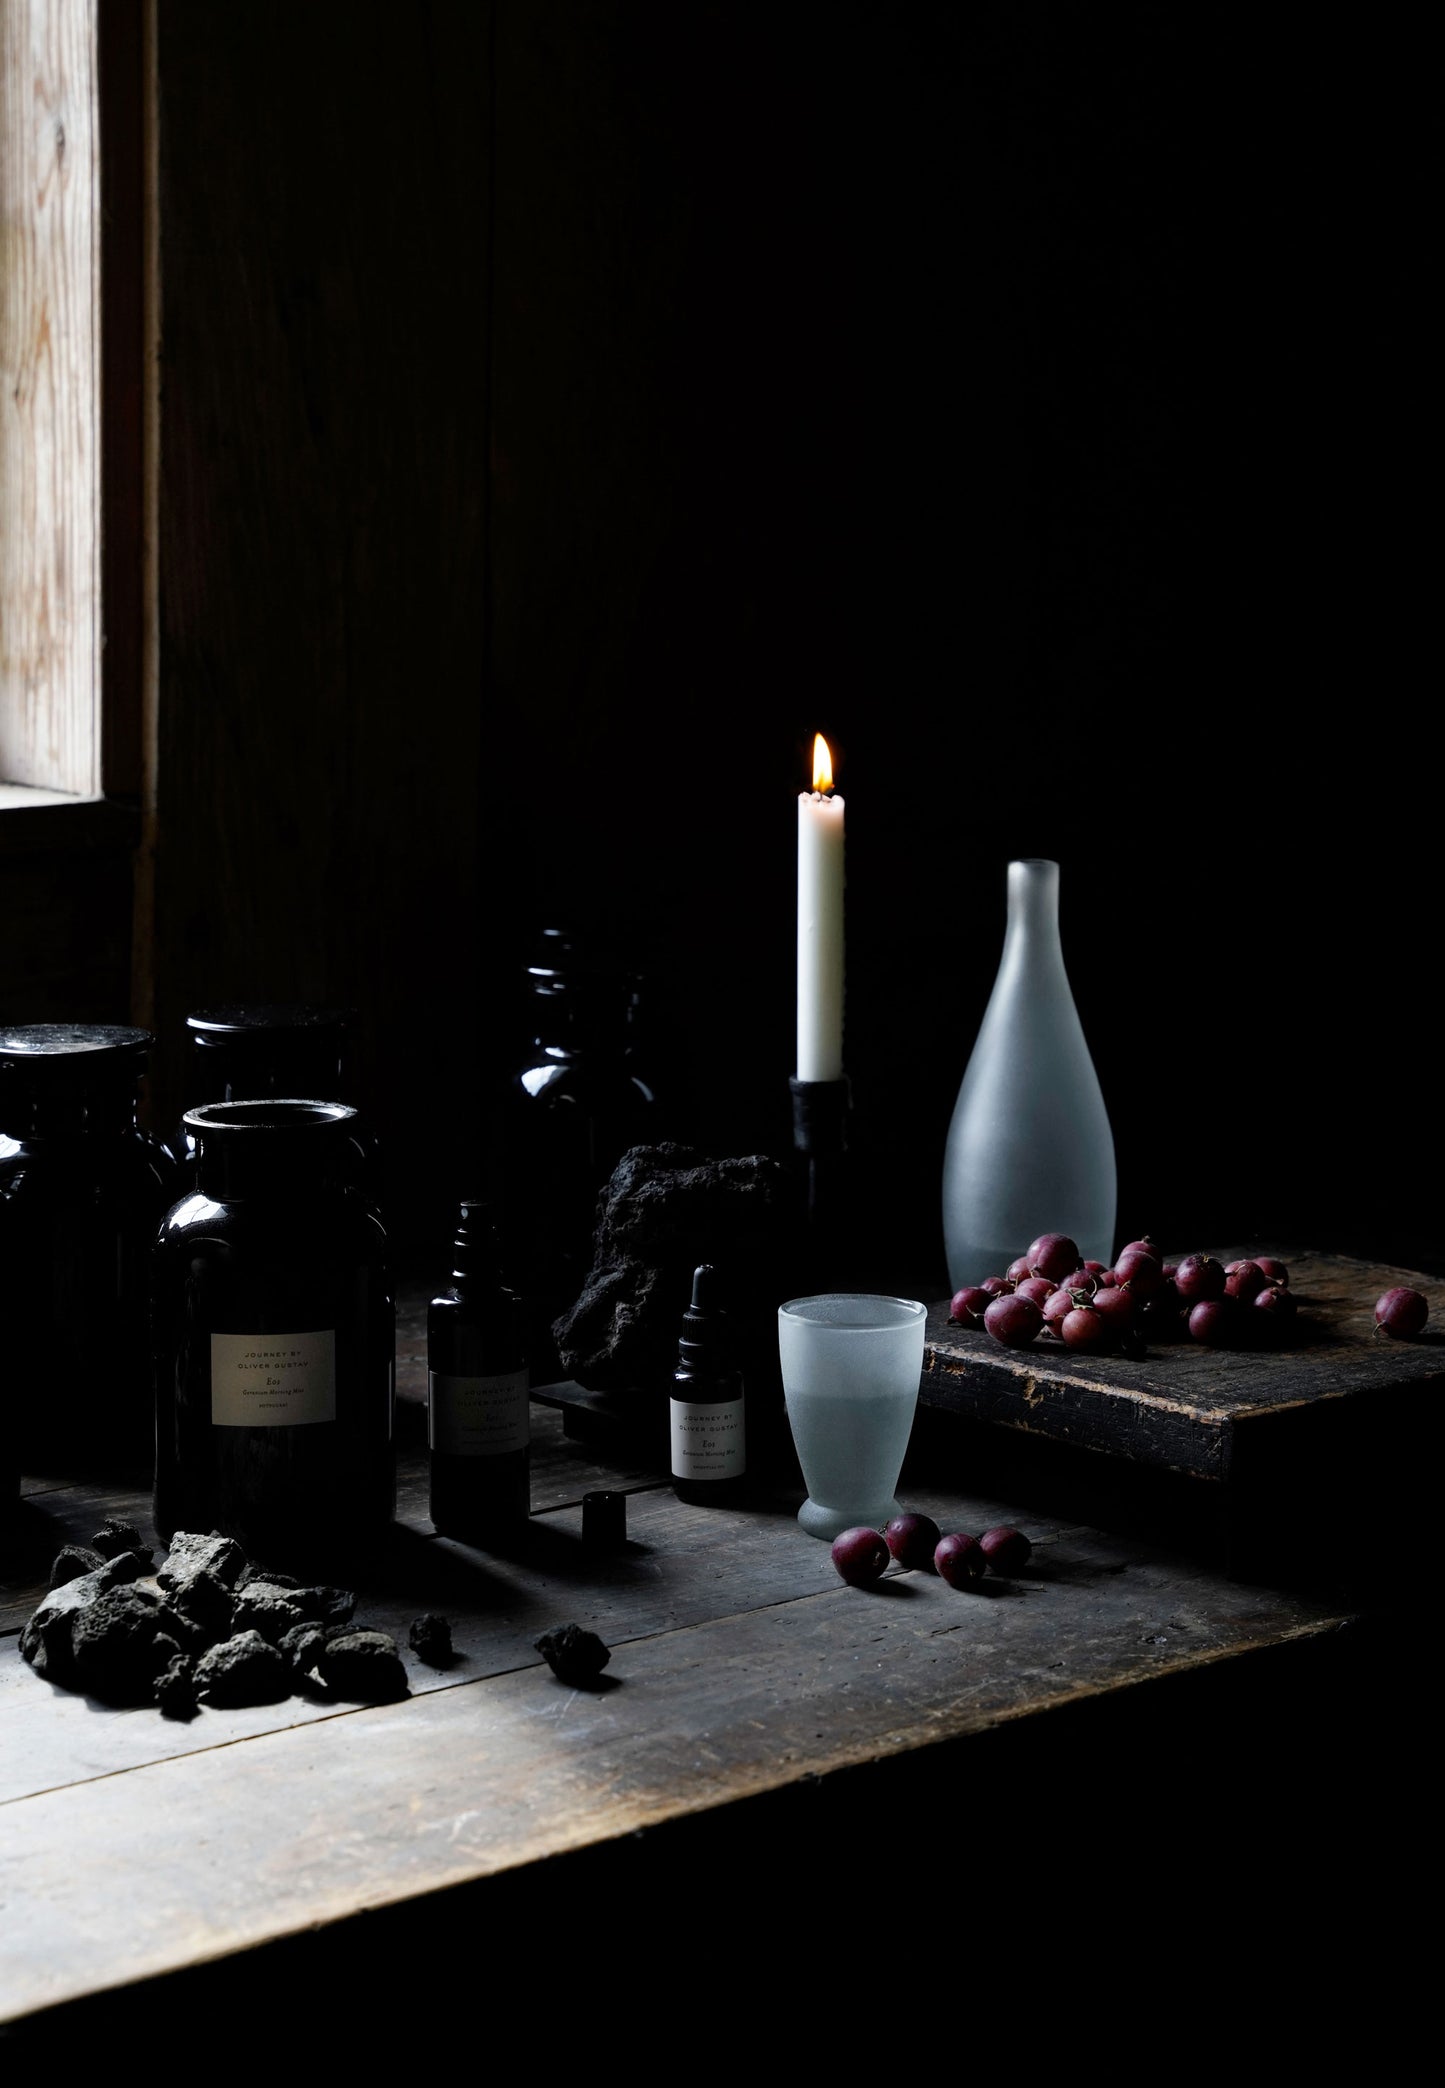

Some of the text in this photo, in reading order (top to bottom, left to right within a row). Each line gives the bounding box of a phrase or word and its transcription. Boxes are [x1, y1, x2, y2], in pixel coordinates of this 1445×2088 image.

[274, 1361, 309, 1369] GUSTAV
[679, 1423, 738, 1432] OLIVER GUSTAV
